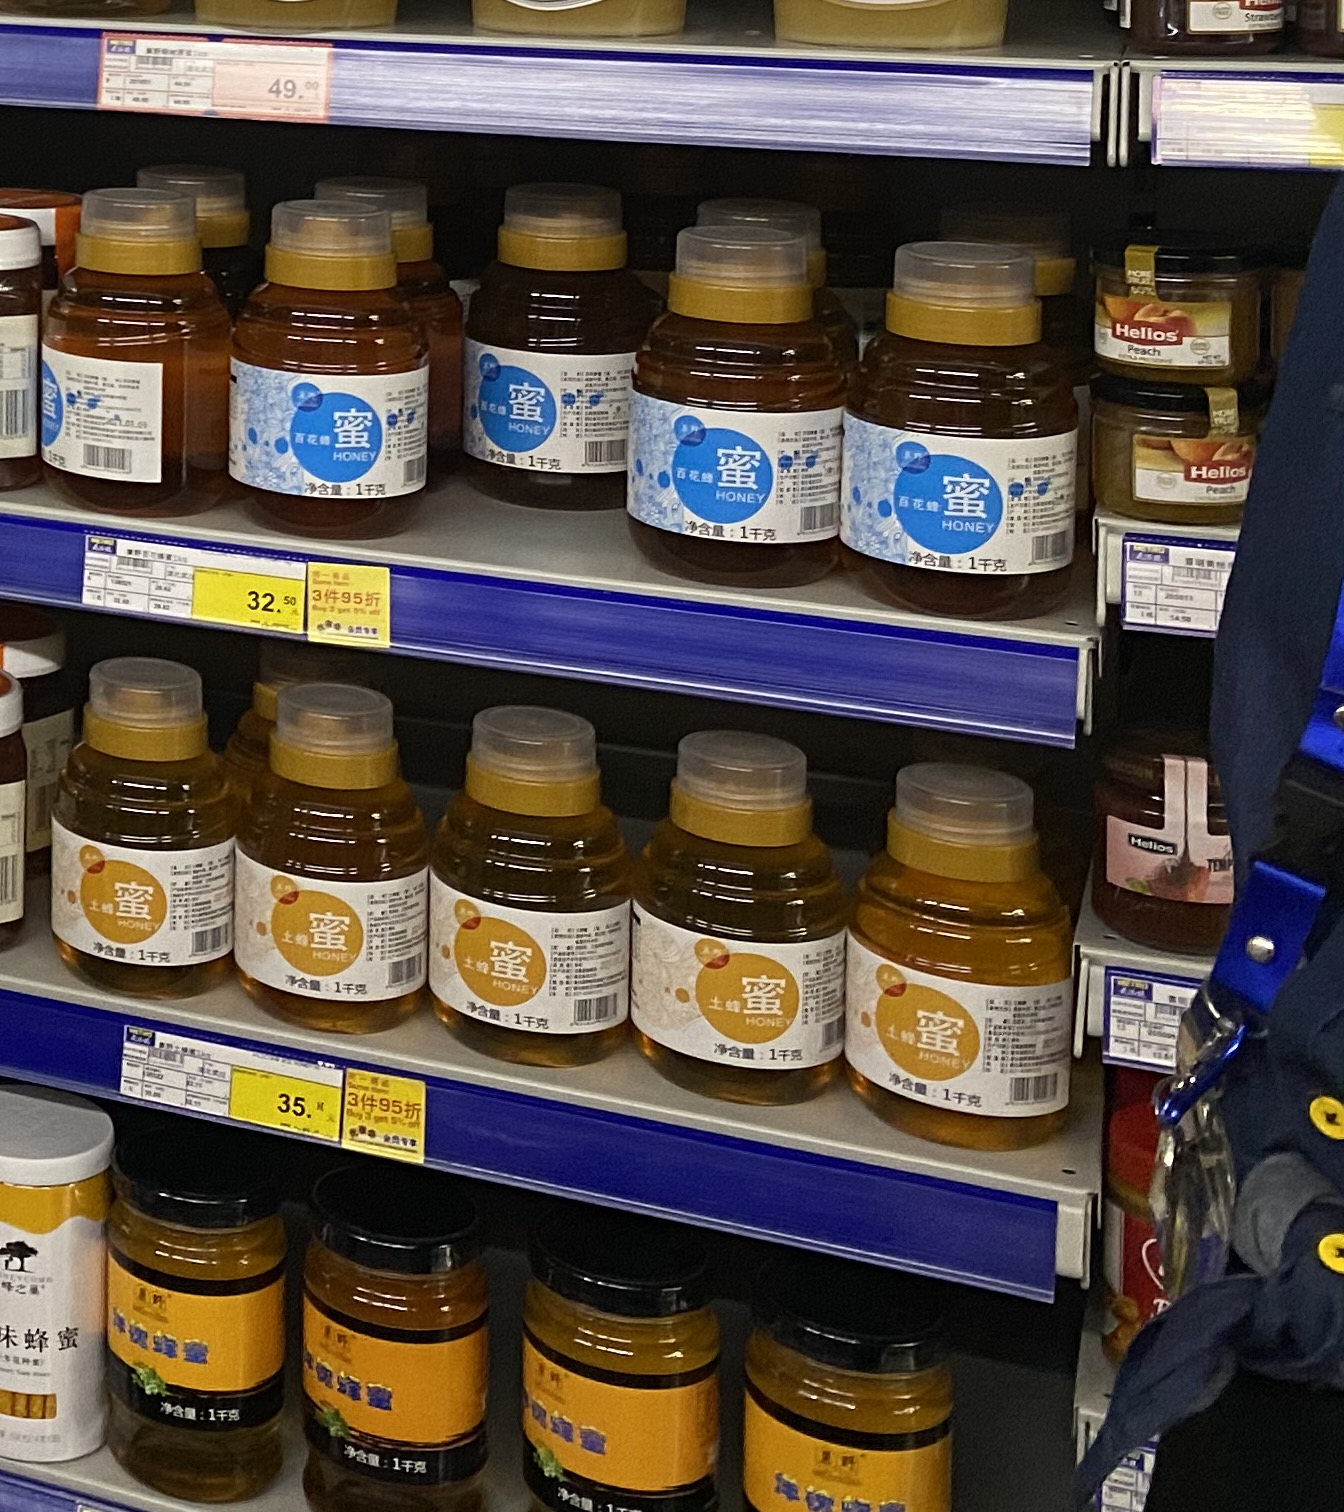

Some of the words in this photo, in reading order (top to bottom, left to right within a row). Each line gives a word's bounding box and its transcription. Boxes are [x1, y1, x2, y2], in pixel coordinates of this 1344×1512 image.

[1116, 324, 1179, 342] Helios
[1127, 345, 1161, 357] Peach
[508, 383, 546, 422] 蜜
[333, 410, 373, 450] 蜜
[509, 423, 550, 436] HONEY
[333, 450, 378, 463] HONEY
[716, 445, 762, 489] 蜜
[1191, 466, 1246, 479] Helios
[715, 490, 766, 505] HONEY
[942, 473, 991, 520] 蜜
[1206, 485, 1236, 495] Peach
[942, 520, 994, 534] HONEY
[247, 591, 297, 614] 32.50
[312, 587, 381, 608] 3件95折
[1131, 836, 1174, 853] Helios
[115, 881, 153, 919] 蜜
[118, 919, 161, 932] HONEY
[309, 912, 349, 950] 蜜
[313, 950, 358, 962] HONEY
[490, 941, 533, 982] 蜜
[492, 982, 539, 996] HONEY
[741, 975, 786, 1016] 蜜
[746, 1016, 793, 1029] HONEY
[916, 1011, 963, 1055] 蜜
[918, 1049, 970, 1070] HONEY
[347, 1091, 422, 1120] 3件95折
